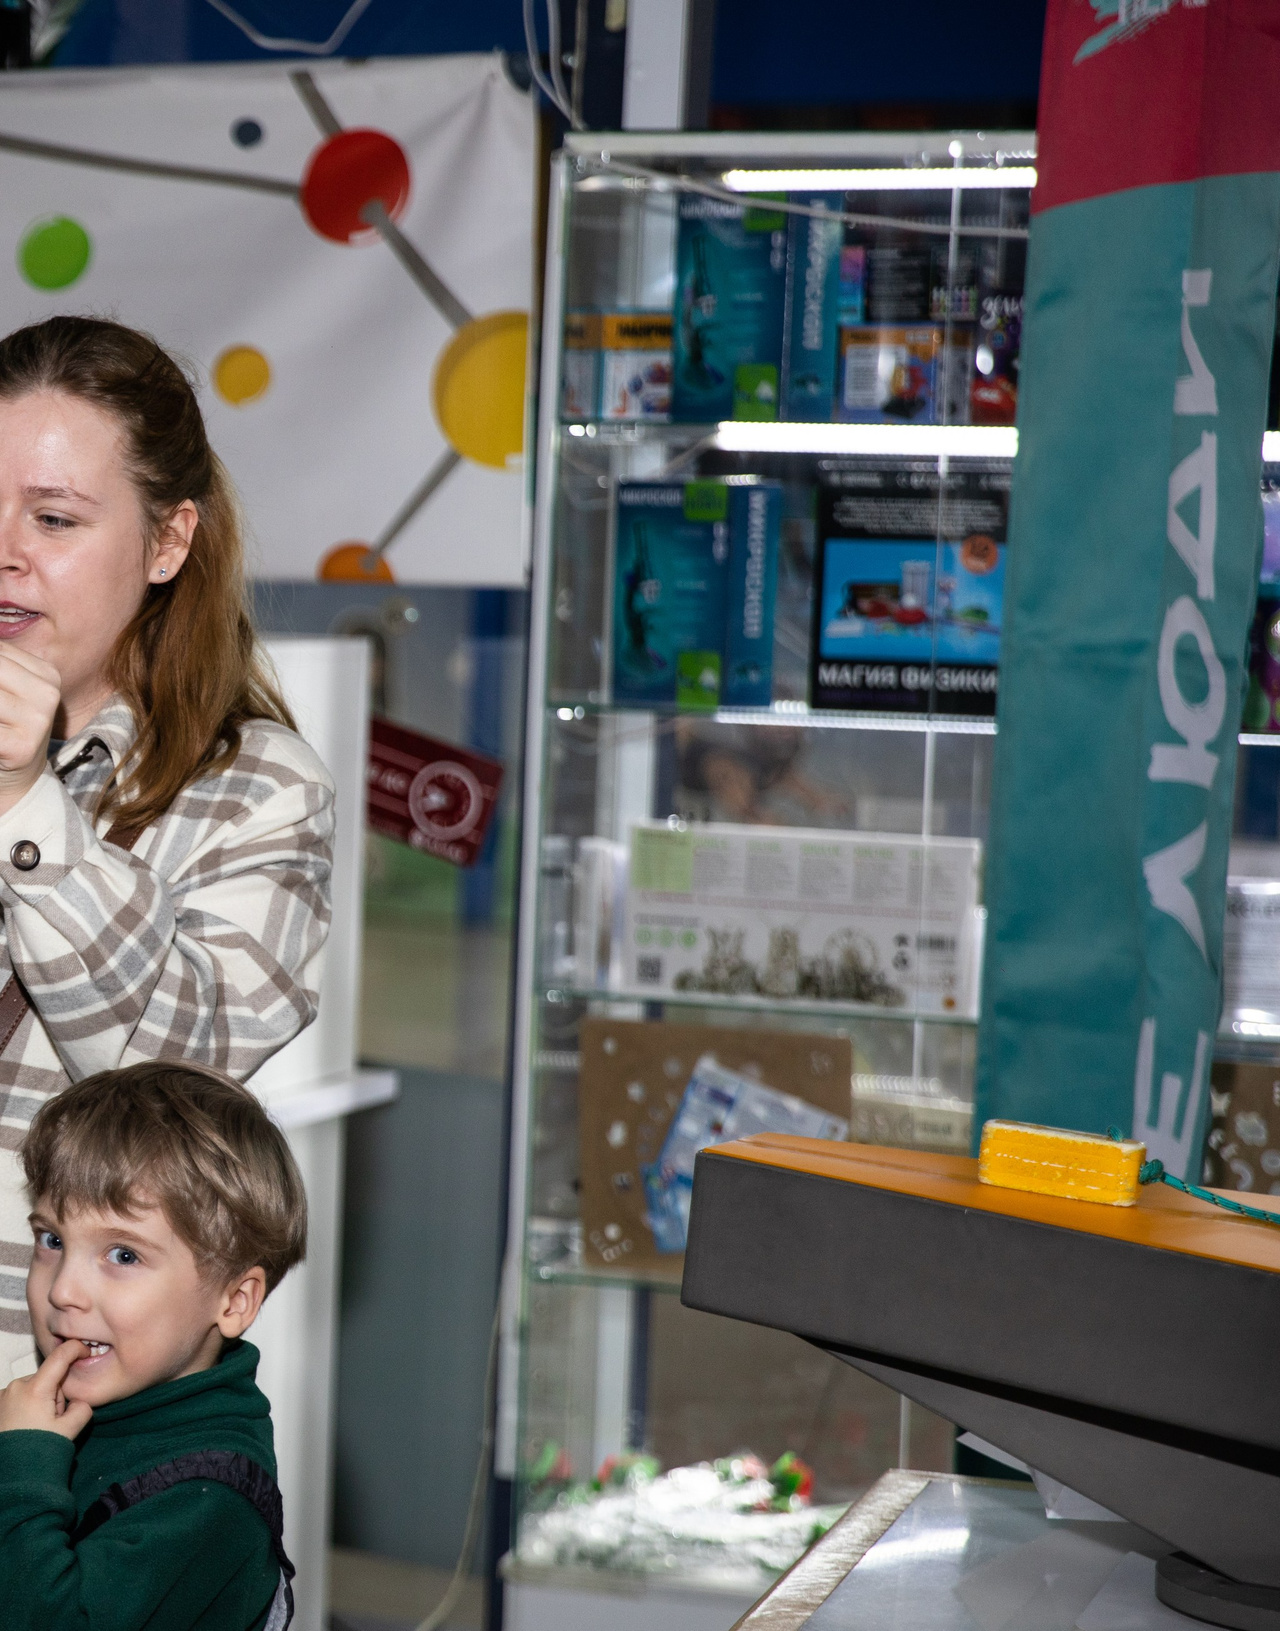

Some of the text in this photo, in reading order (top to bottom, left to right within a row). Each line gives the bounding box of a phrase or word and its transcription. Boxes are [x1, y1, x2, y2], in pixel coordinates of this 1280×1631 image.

[818, 663, 998, 693] МАГИЯ ФИЗИКИ
[1142, 268, 1226, 965] ЛЮДИ
